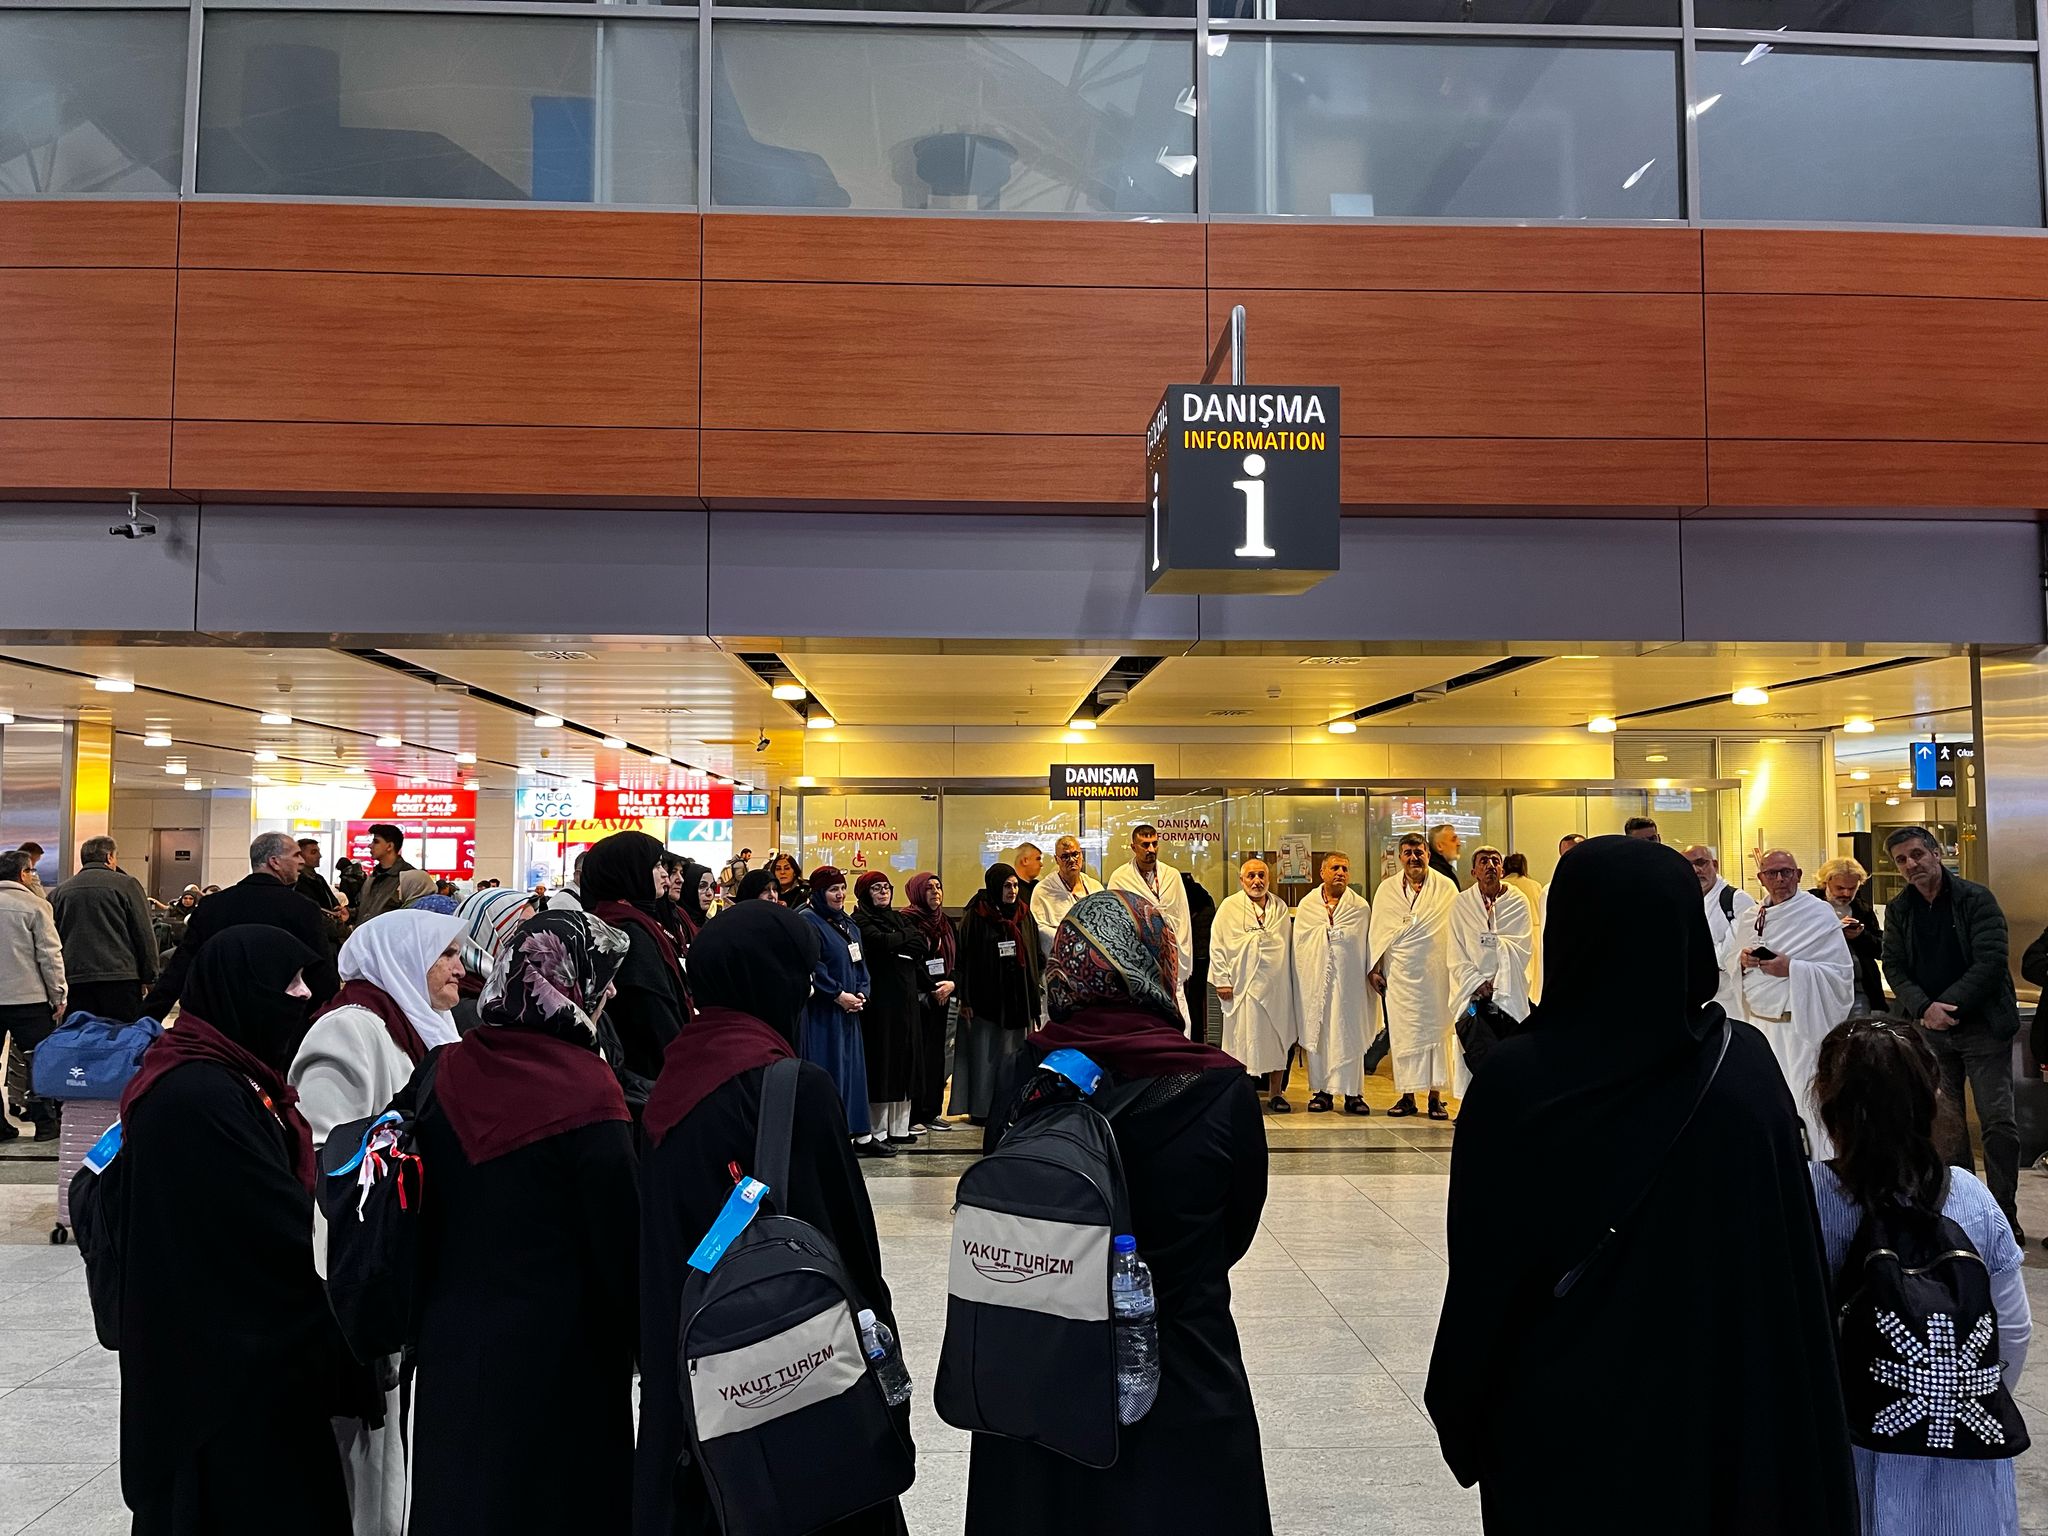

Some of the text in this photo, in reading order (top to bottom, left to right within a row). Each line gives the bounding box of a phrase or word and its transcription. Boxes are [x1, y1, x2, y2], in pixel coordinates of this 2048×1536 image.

[1183, 393, 1326, 429] DANIŞMA
[1184, 430, 1326, 450] INFORMATION
[1065, 767, 1139, 786] DANIŞMA
[617, 790, 663, 806] BİLET
[1066, 786, 1139, 797] INFORMATION
[617, 805, 710, 817] TICKET SALES
[834, 818, 886, 830] DANIŞMA
[1157, 819, 1209, 830] DANIŞMA
[821, 832, 898, 841] INFORMATION
[1156, 832, 1220, 841] FORMATION
[962, 1239, 1074, 1275] YAKUT TURİZM
[718, 1344, 835, 1401] YAKUT TURİZM
